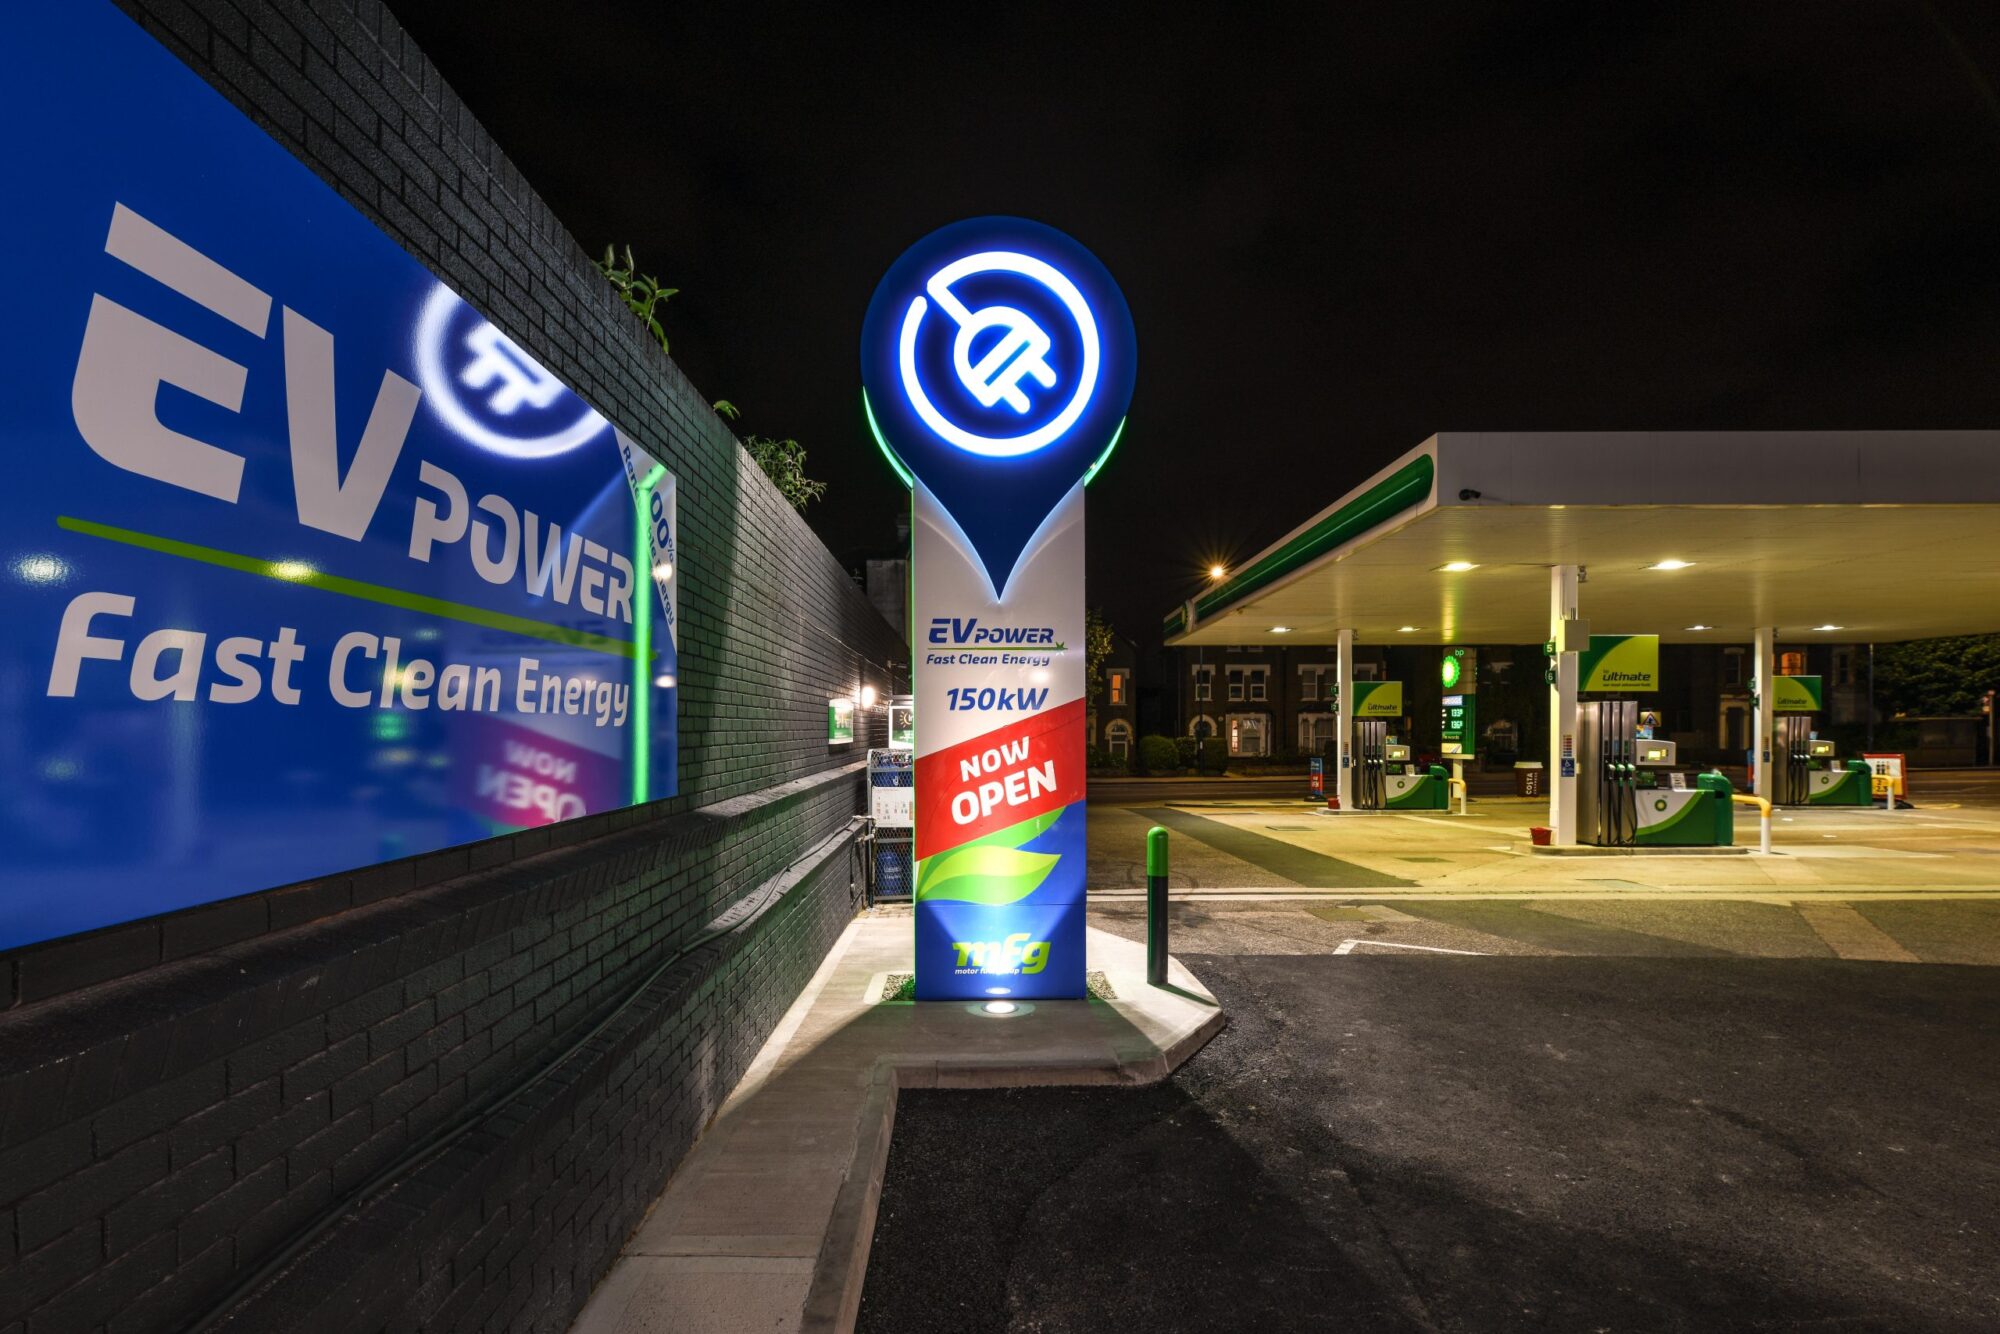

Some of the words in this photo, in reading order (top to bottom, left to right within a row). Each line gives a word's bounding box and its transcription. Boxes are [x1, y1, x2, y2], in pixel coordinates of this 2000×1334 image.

[72, 201, 422, 542] EV
[408, 459, 634, 625] POWER
[928, 618, 978, 644] EV
[974, 627, 1054, 644] POWER
[46, 591, 306, 706] Fast
[328, 631, 502, 714] Clean
[515, 656, 630, 727] Energy
[926, 653, 956, 665] Fast
[959, 653, 997, 665] Clean
[1001, 653, 1050, 667] Energy
[1602, 671, 1651, 682] ultimate
[946, 687, 1050, 711] 150kW
[959, 735, 1030, 783] NOW
[951, 759, 1057, 826] OPEN
[1525, 772, 1534, 795] COSTA
[951, 932, 1052, 975] mfg
